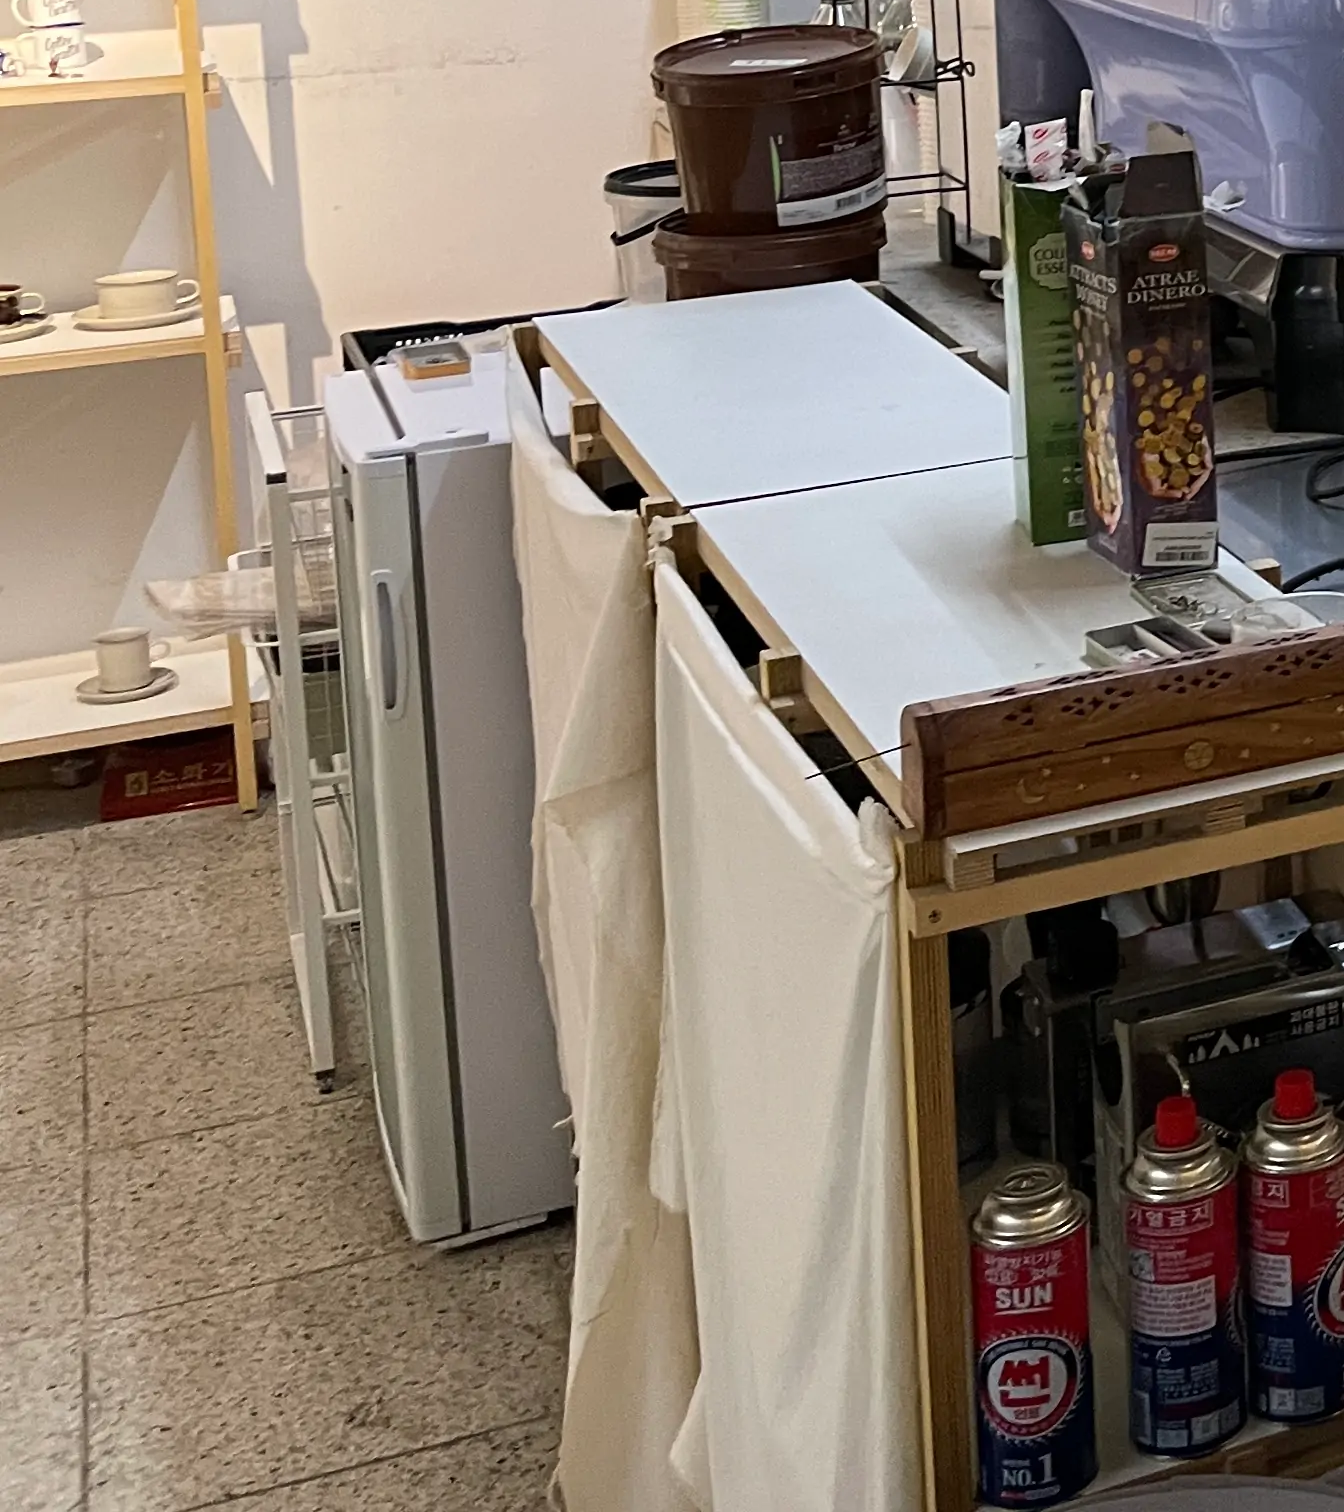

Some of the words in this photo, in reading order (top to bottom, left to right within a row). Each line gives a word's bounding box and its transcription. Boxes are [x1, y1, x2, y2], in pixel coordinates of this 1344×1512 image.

[1132, 270, 1199, 290] ATRAE
[1127, 284, 1206, 304] DINERO
[995, 1282, 1053, 1309] SUN
